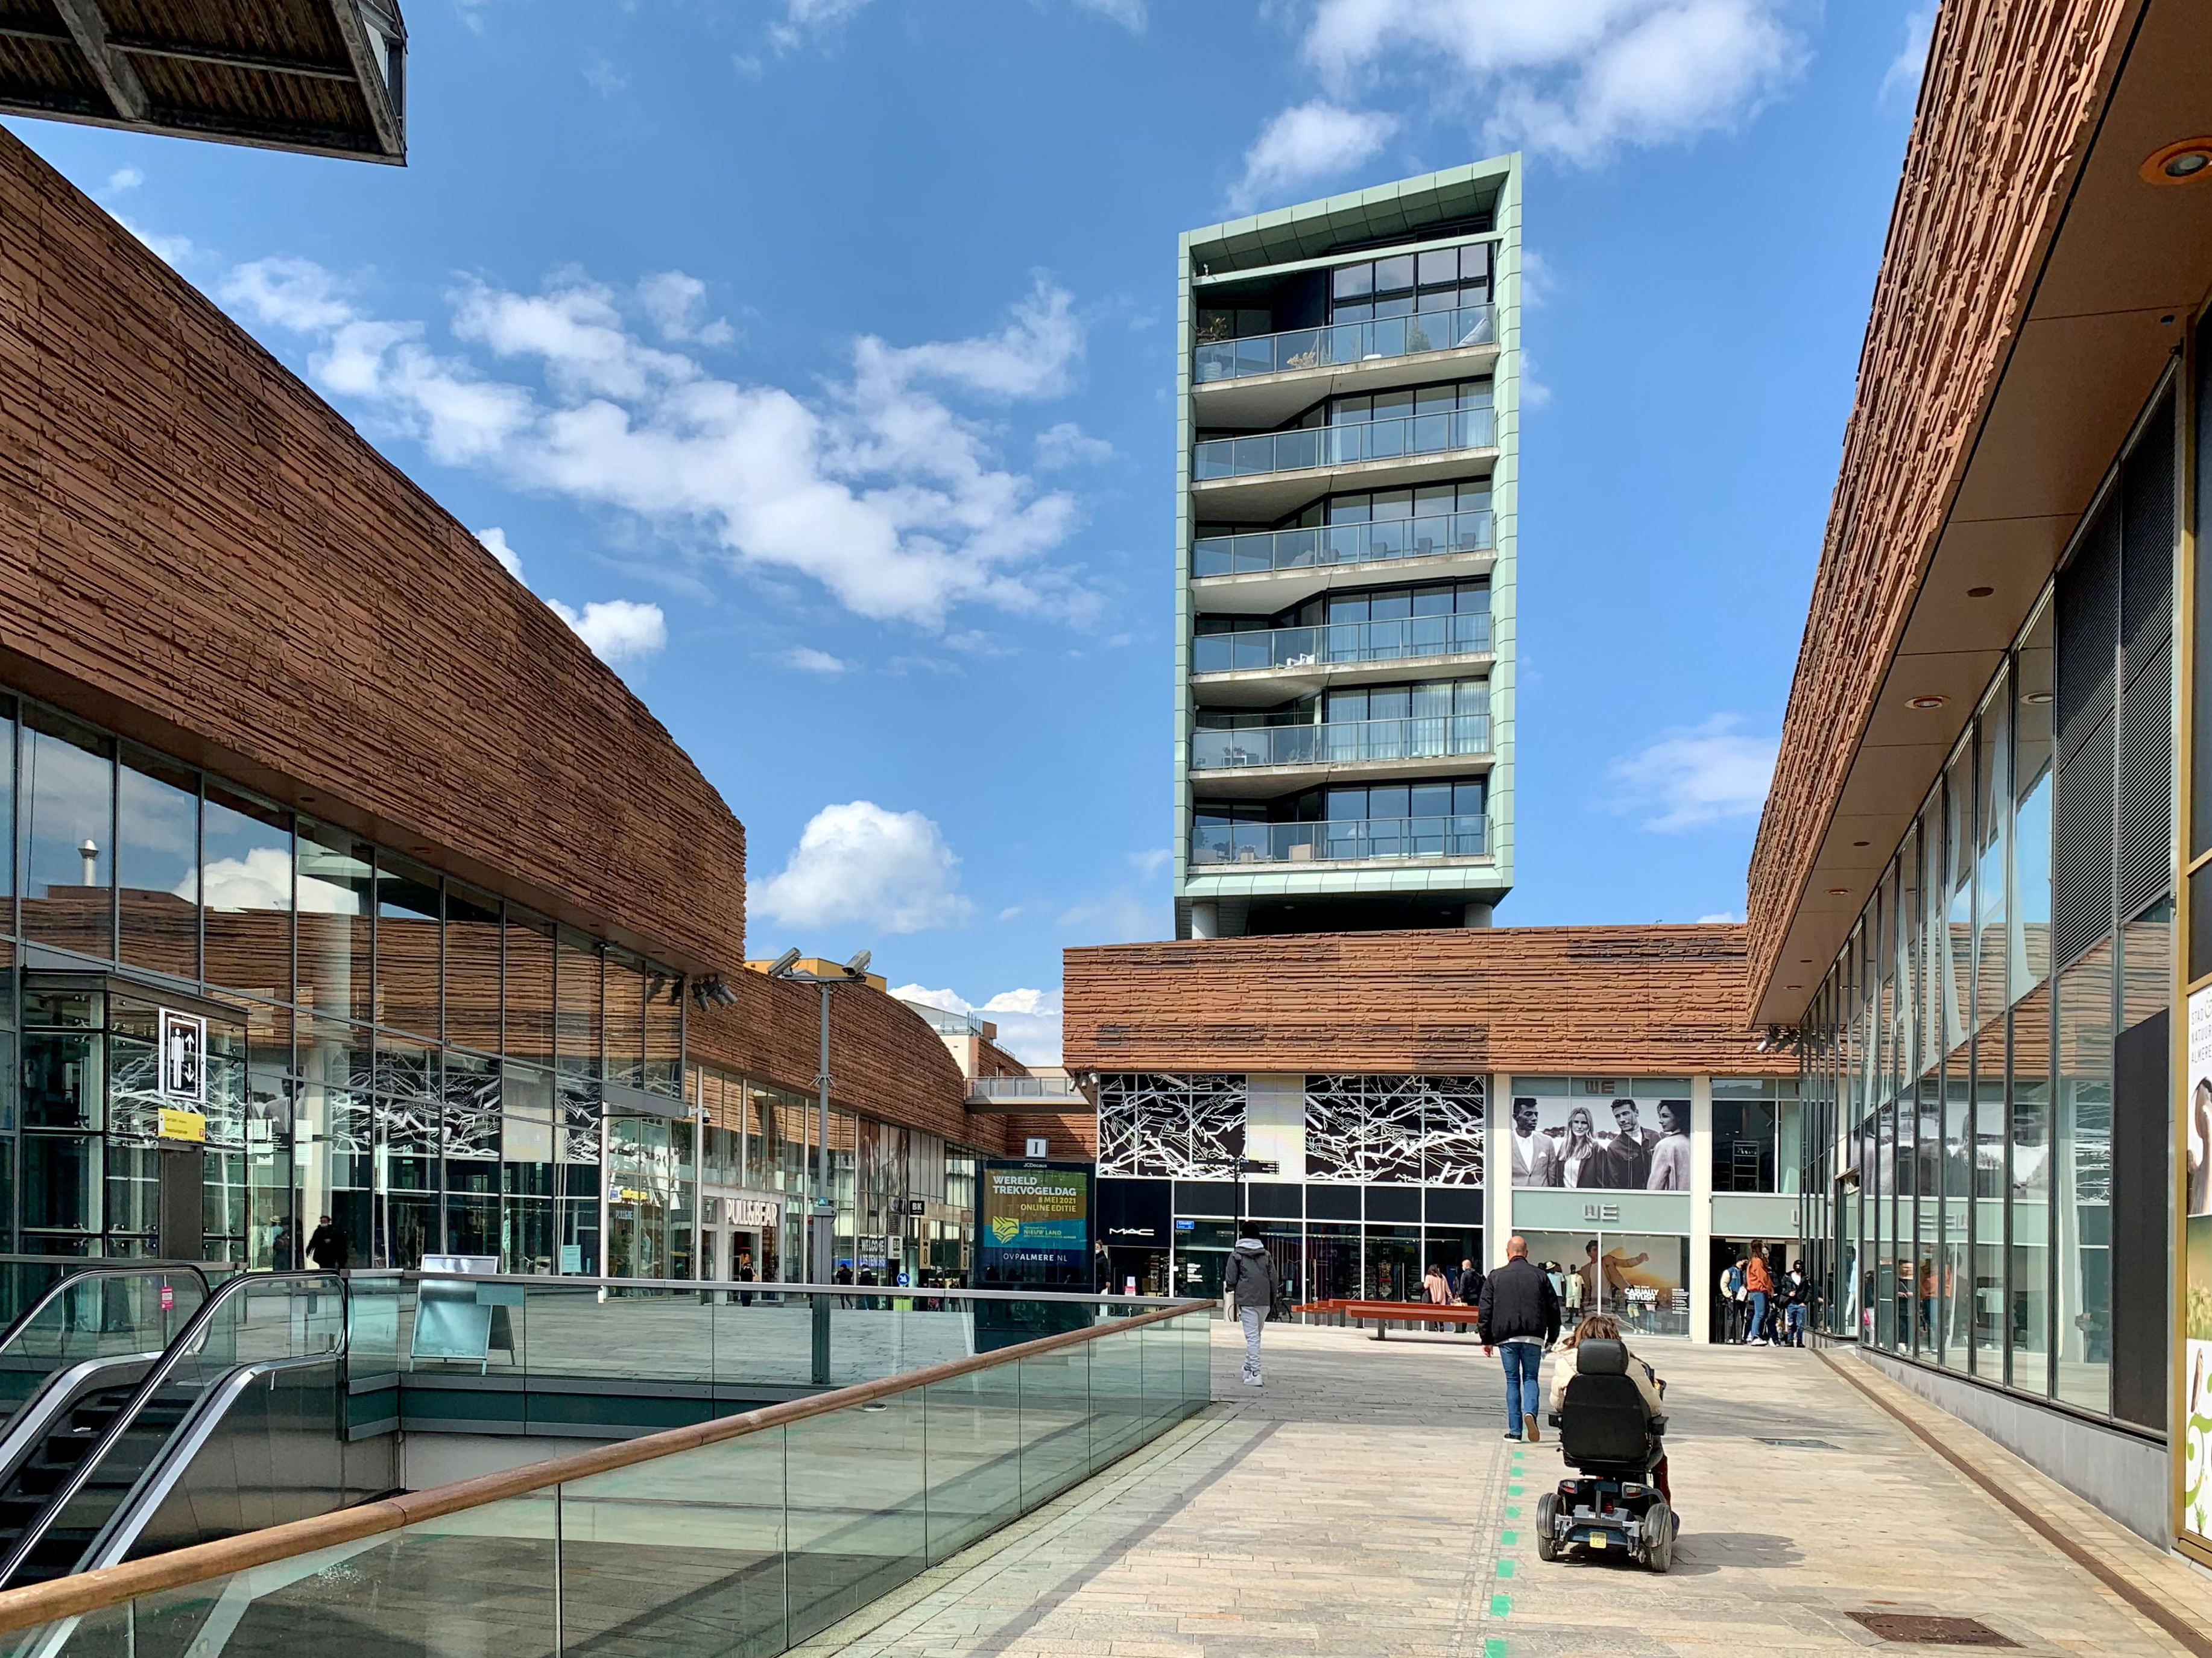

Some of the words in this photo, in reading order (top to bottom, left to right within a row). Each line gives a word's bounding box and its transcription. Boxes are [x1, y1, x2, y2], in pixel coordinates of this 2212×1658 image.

[2191, 1008, 2204, 1025] STAD
[2191, 1045, 2212, 1064] ALMERE
[993, 1175, 1037, 1186] WERELD
[992, 1185, 1077, 1196] TREKVOGELDAG
[912, 1202, 922, 1210] BK
[726, 1198, 777, 1227] PULL&BEAR
[860, 1254, 886, 1267] LISTENRS
[1624, 1288, 1660, 1296] CASUALLY
